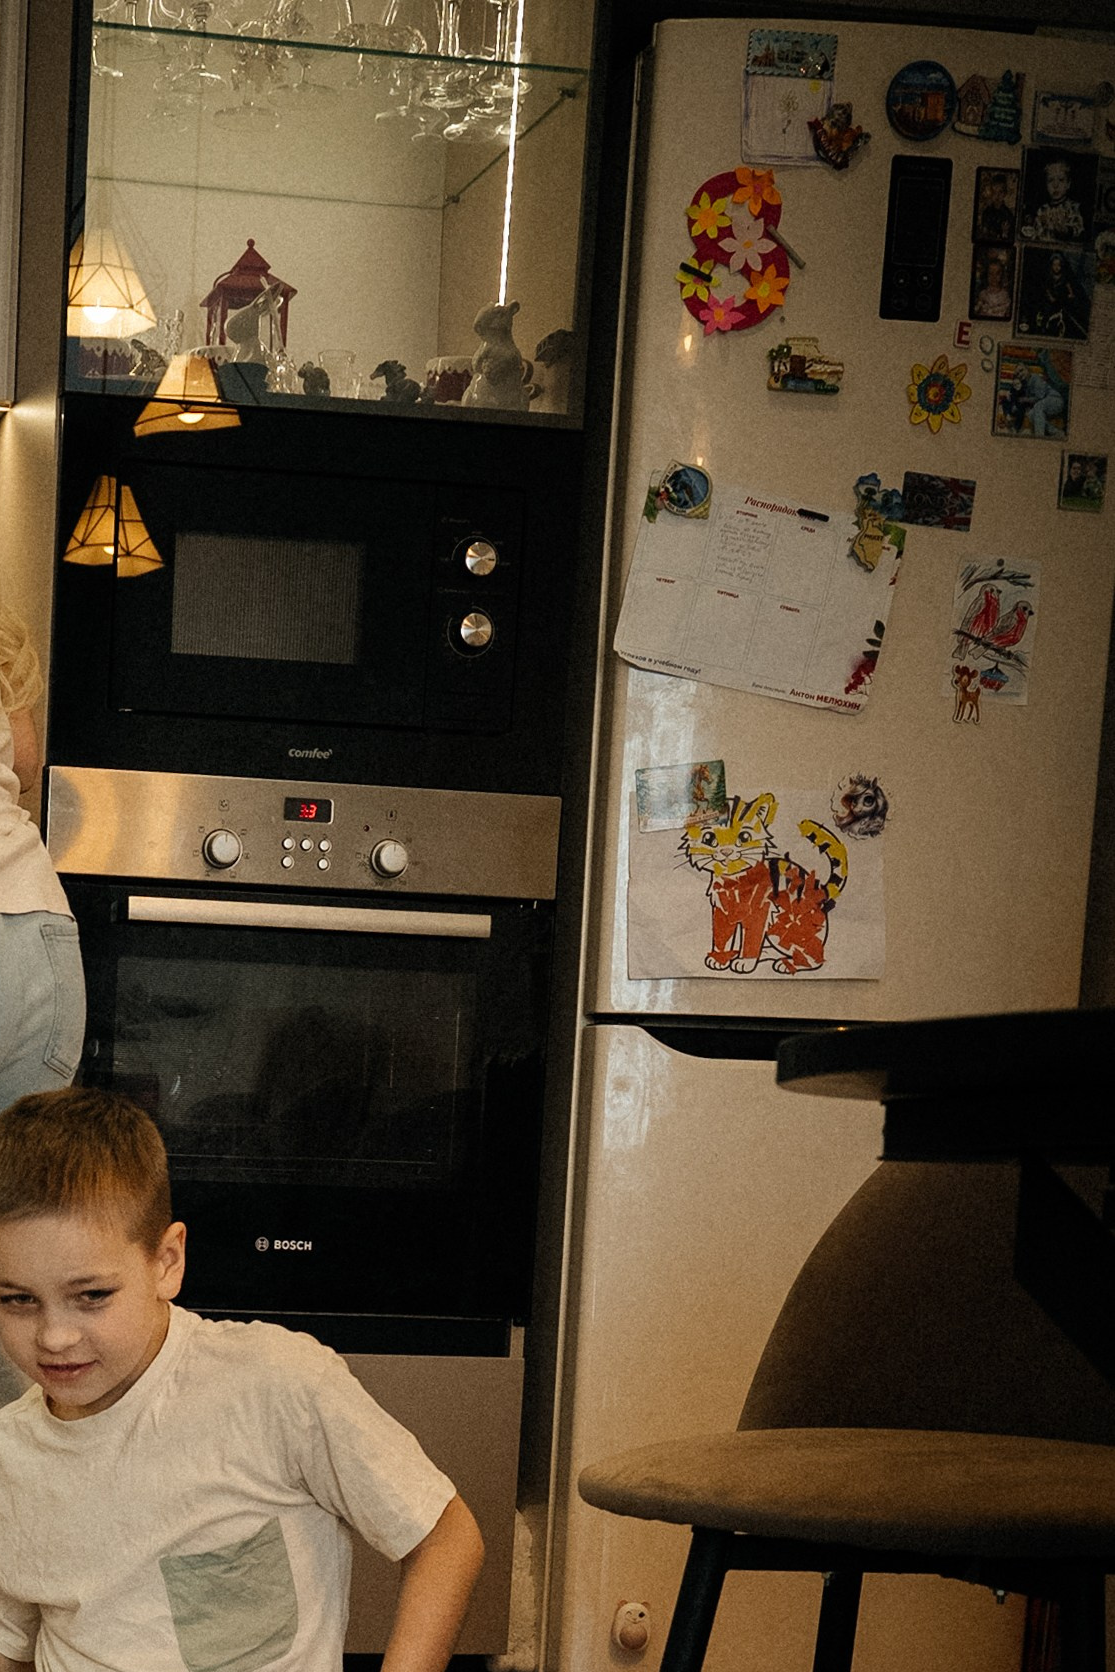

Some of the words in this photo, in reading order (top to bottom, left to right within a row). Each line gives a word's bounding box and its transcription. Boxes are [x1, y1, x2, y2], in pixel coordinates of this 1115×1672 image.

[956, 321, 972, 345] E
[815, 694, 862, 711] МЕЛЮХИН
[273, 1239, 313, 1251] BOSCH
